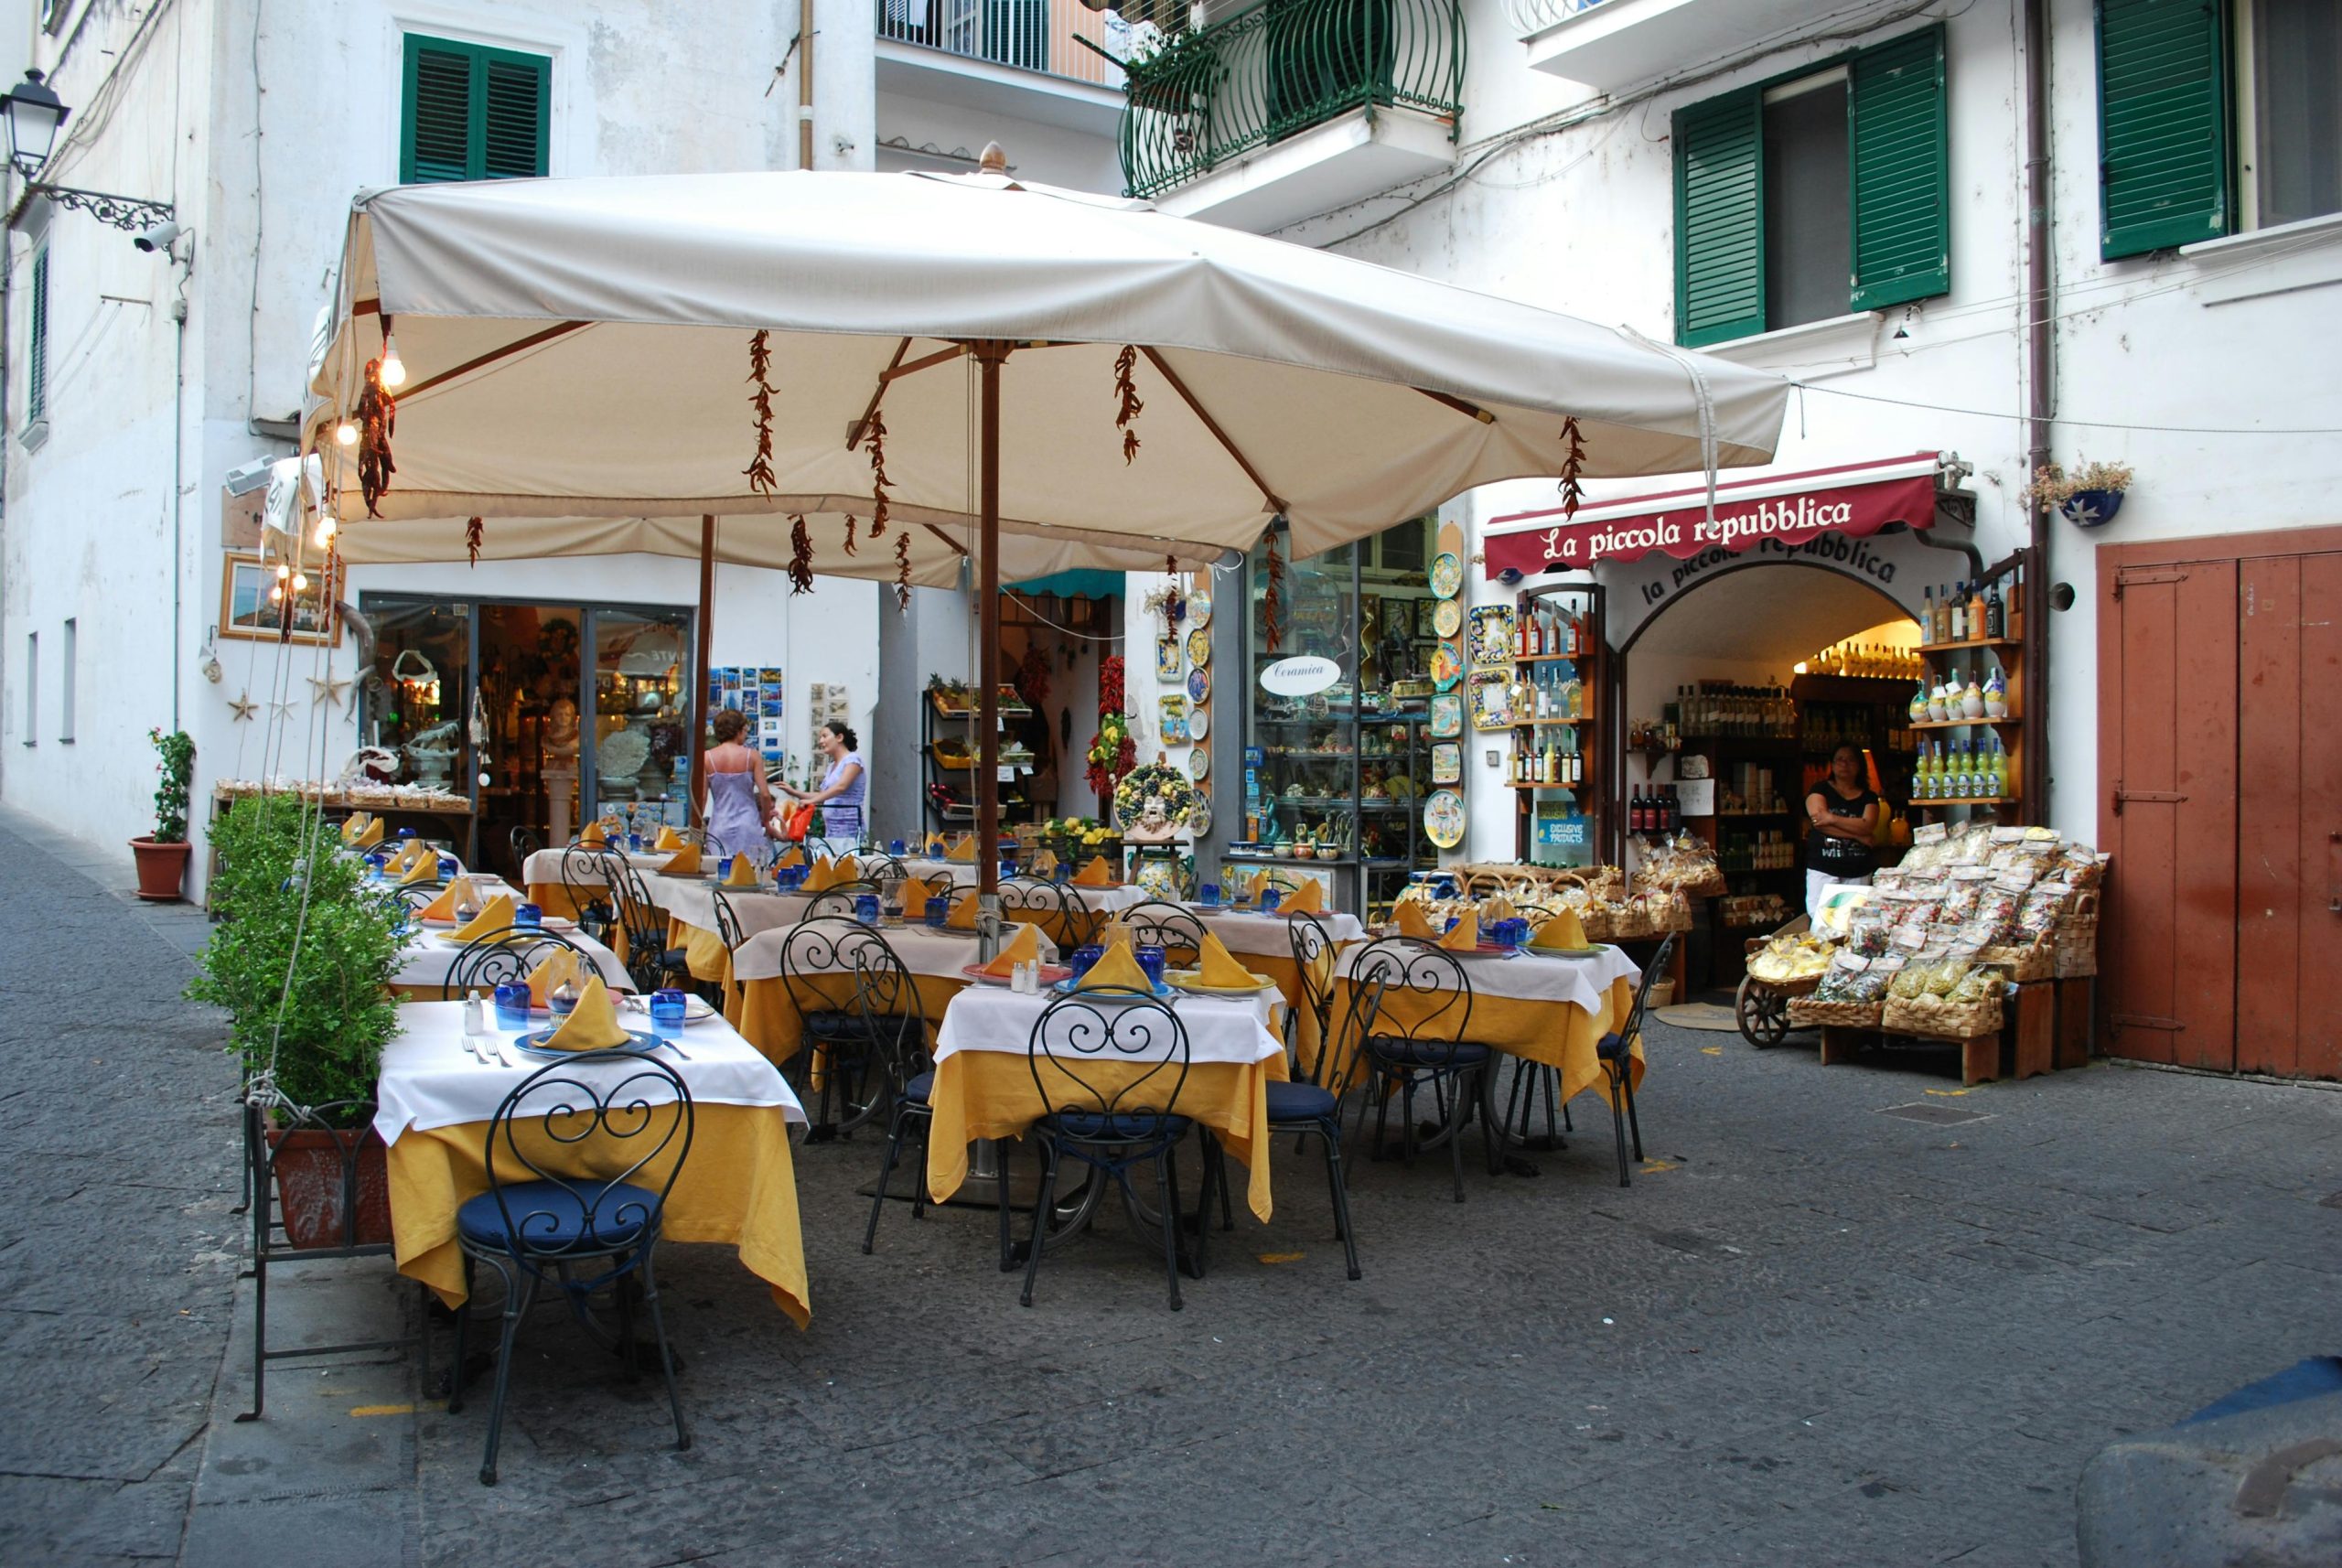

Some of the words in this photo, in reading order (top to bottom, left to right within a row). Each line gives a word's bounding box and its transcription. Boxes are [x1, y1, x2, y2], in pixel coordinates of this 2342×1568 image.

[1540, 527, 1577, 559] La
[1588, 516, 1681, 560] piccola
[1642, 581, 1665, 606] la
[1273, 661, 1325, 678] Ceramica
[1550, 824, 1584, 833] EXCLUSIVE
[1550, 834, 1584, 843] PRODUCTS
